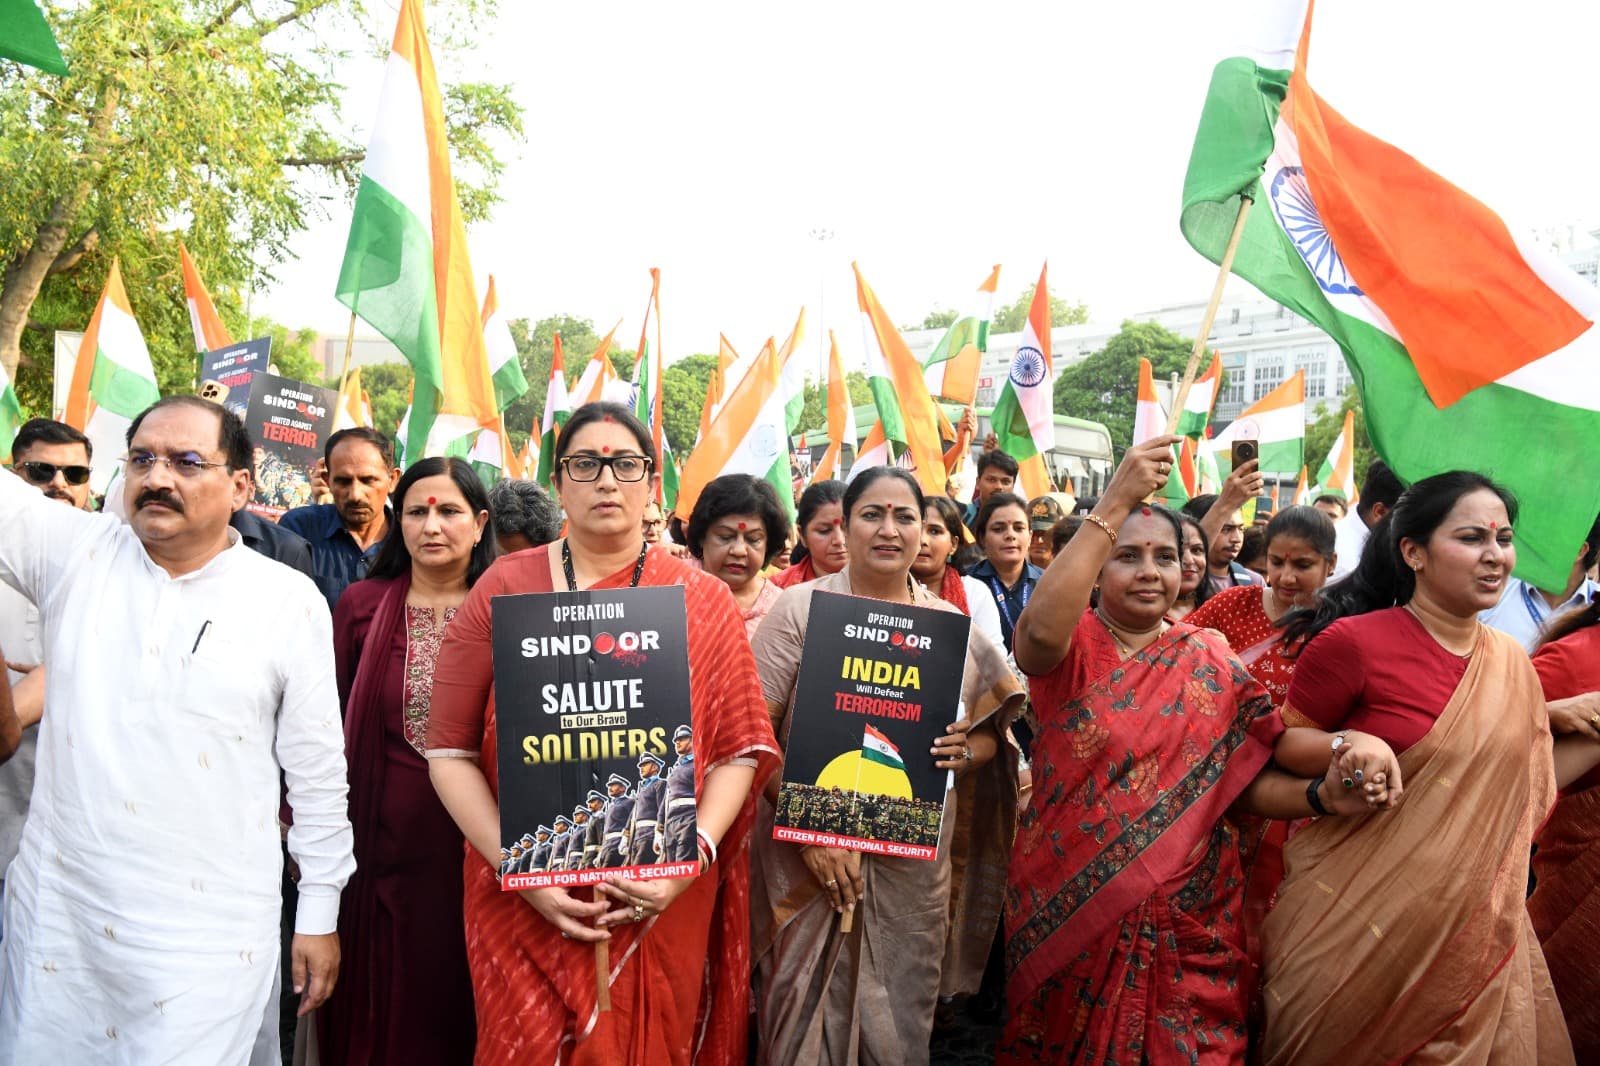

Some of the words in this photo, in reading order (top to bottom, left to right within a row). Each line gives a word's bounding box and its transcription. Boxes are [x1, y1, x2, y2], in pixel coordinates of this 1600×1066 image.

[263, 394, 326, 418] SINDOOR
[280, 388, 314, 403] OPERATION
[263, 422, 318, 449] TERROR
[271, 416, 291, 426] UNITED
[290, 419, 313, 431] AGAINST
[553, 602, 625, 623] OPERATION
[867, 612, 914, 630] OPERATION
[521, 630, 660, 658] SINDOOR
[843, 624, 932, 651] SINDOOR
[841, 655, 921, 690] INDIA
[541, 678, 644, 715] SALUTE
[856, 684, 873, 696] Will
[874, 686, 904, 699] Defeat
[834, 691, 922, 723] TERRORISM
[562, 716, 573, 728] to
[576, 715, 595, 728] Our
[597, 714, 626, 726] Brave
[522, 726, 668, 766] SOLDIERS
[777, 829, 815, 843] CITIZEN
[816, 834, 836, 846] FOR
[837, 838, 885, 852] NATIONAL
[887, 844, 933, 858] SECURITY
[508, 876, 552, 888] CITIZEN
[554, 873, 577, 885] FOR
[639, 864, 695, 879] SECURITY
